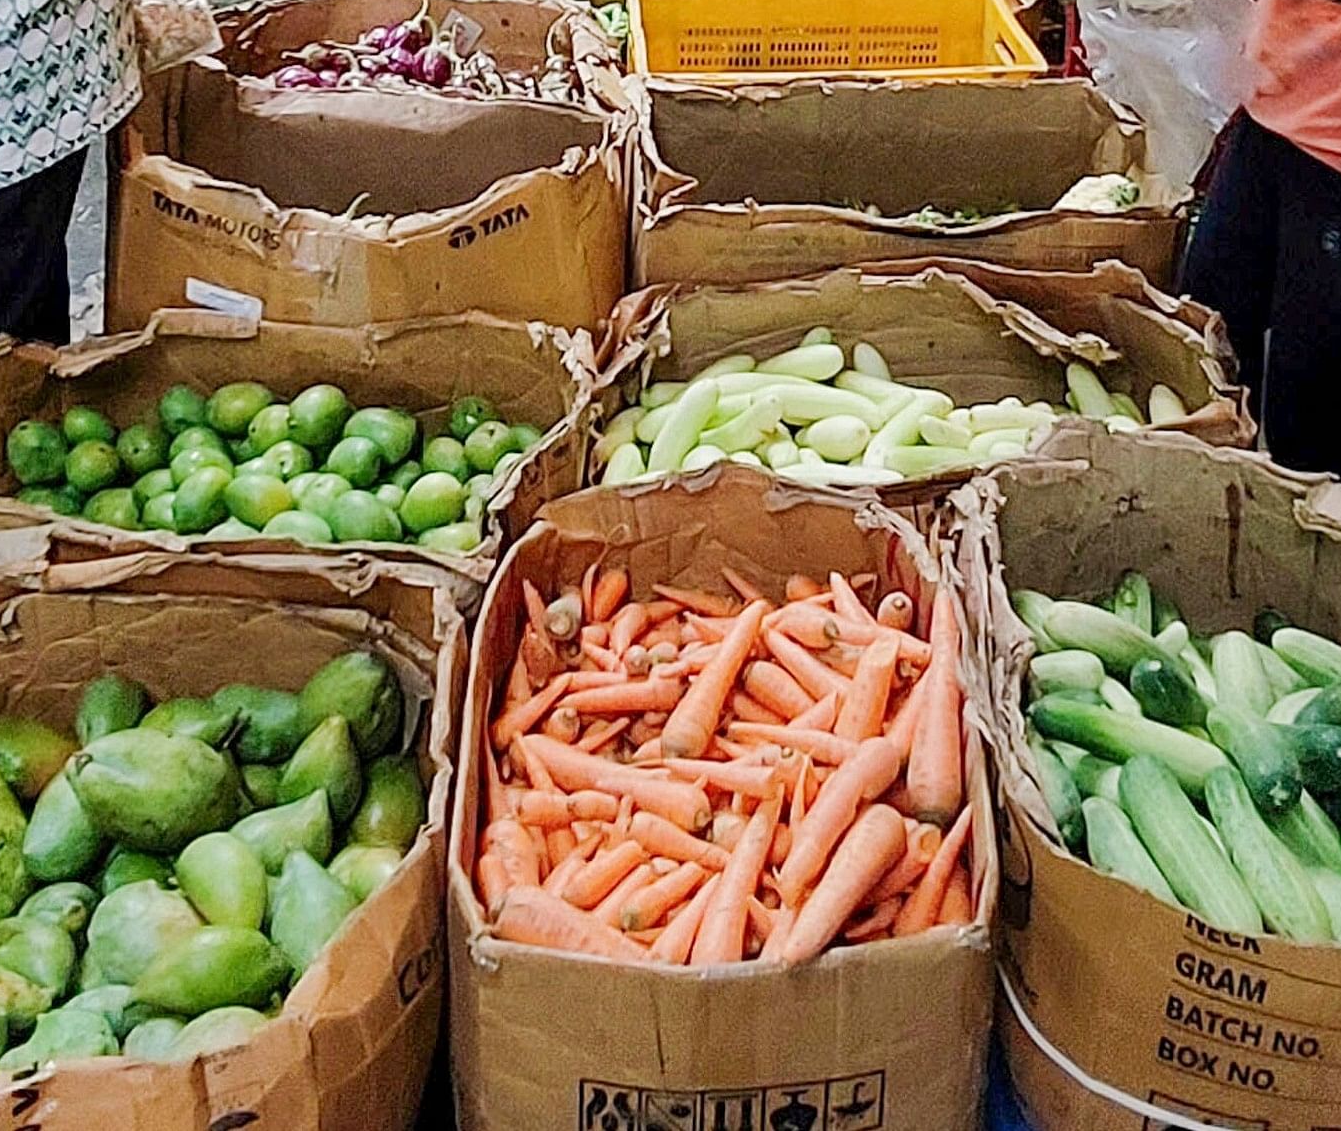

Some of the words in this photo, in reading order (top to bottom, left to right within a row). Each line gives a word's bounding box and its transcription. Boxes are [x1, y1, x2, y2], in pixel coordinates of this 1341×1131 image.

[151, 190, 199, 225] TATA
[202, 213, 281, 251] MOTORS
[479, 203, 530, 237] TATA
[1174, 951, 1269, 1005] GRAM
[1165, 995, 1264, 1049] BATCH
[1270, 1029, 1325, 1060] NO.
[1157, 1035, 1220, 1078] BOX
[1226, 1061, 1279, 1094] NO.
